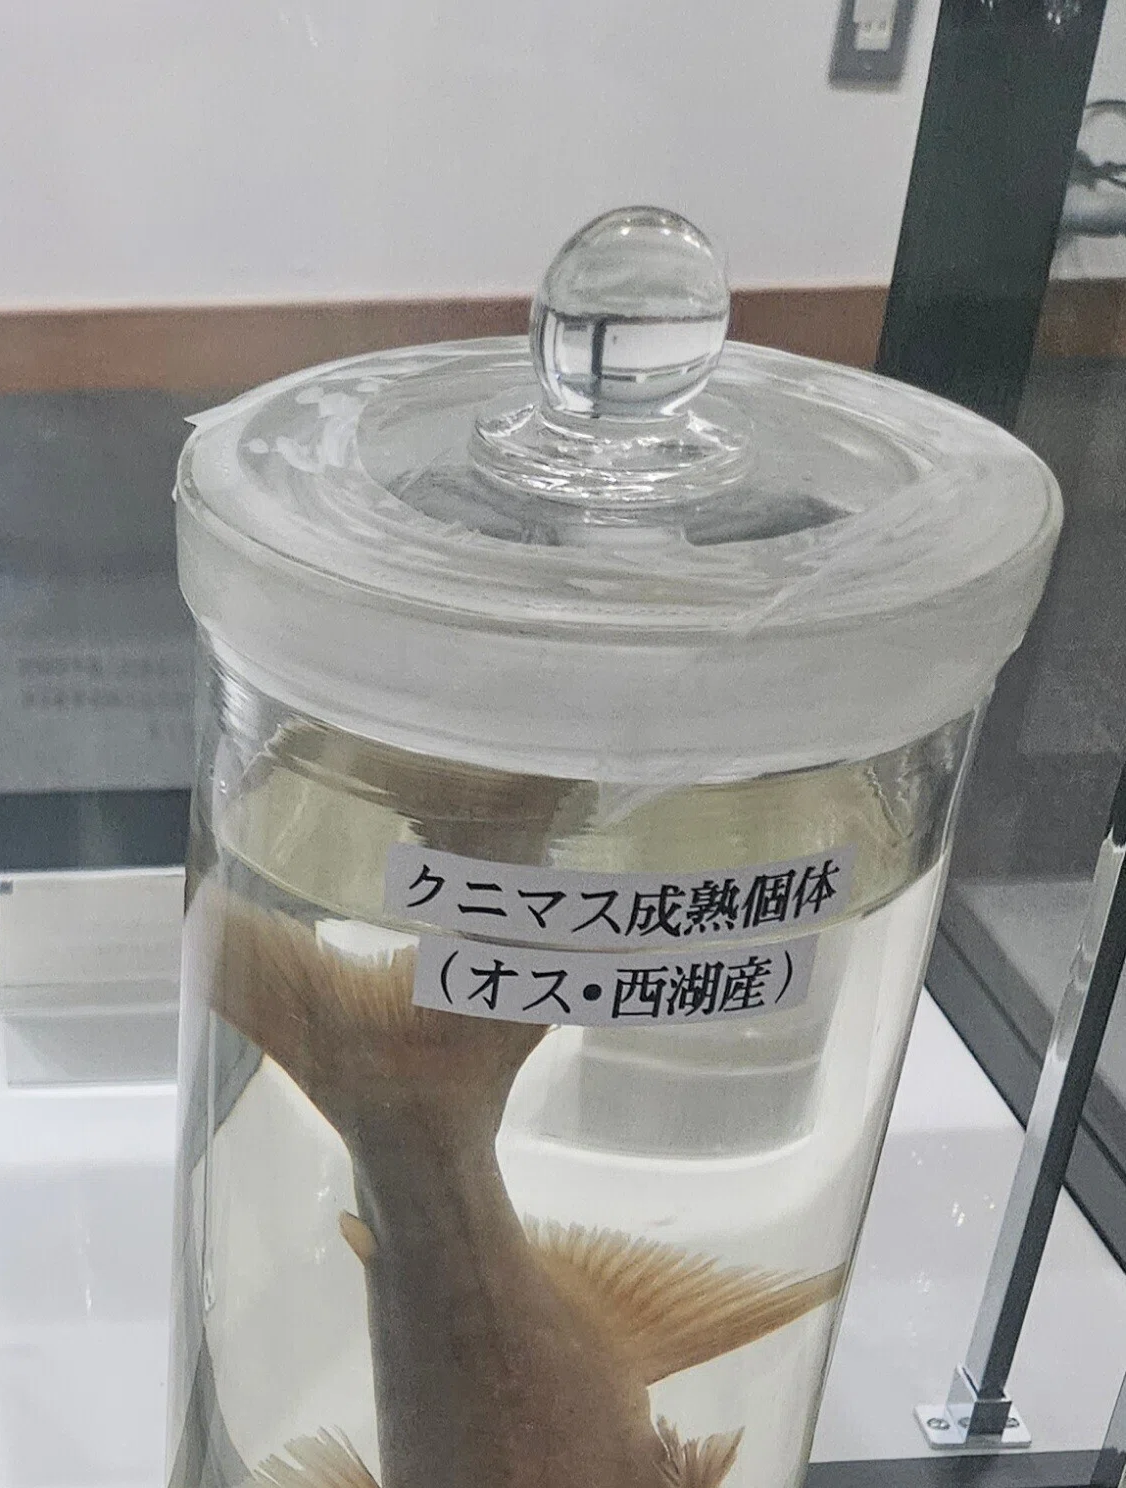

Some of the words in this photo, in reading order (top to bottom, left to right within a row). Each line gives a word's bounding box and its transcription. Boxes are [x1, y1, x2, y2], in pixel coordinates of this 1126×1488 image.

[407, 859, 840, 938] クニマス成熟個体
